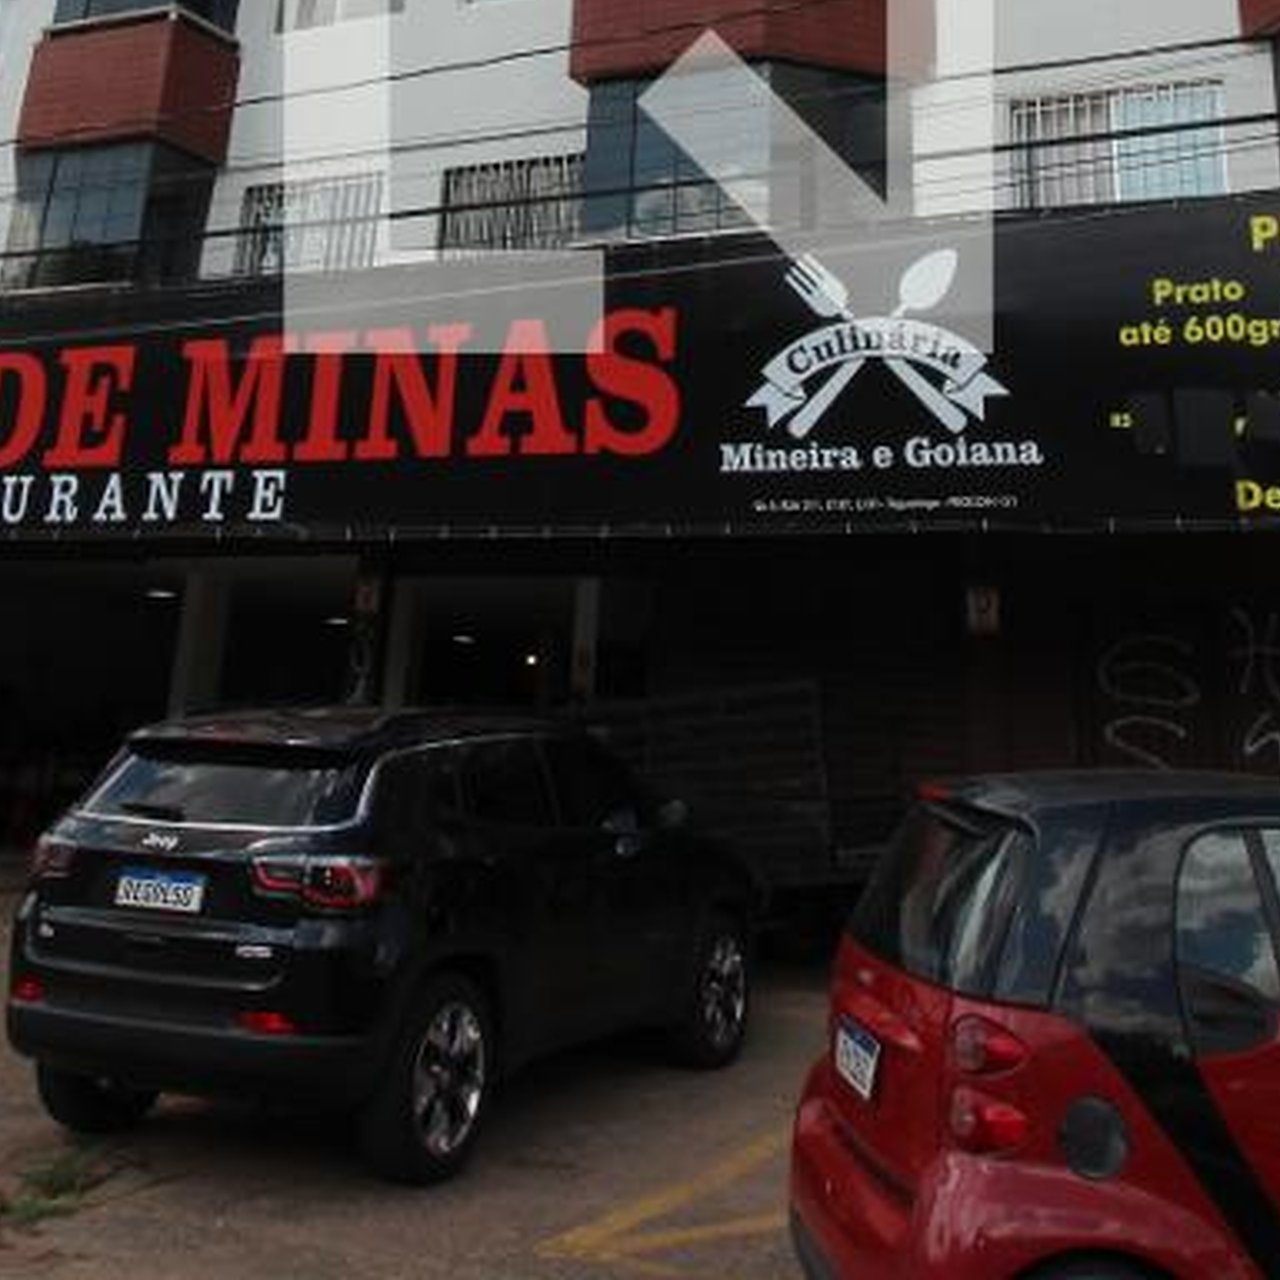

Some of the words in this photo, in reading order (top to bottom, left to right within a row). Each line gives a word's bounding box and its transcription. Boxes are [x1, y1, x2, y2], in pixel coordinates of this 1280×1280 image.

[1152, 278, 1245, 305] Prato
[1119, 319, 1171, 345] até
[168, 307, 682, 464] MINAS
[720, 440, 861, 472] Mineira
[872, 444, 894, 467] e
[904, 436, 1044, 469] Goiana
